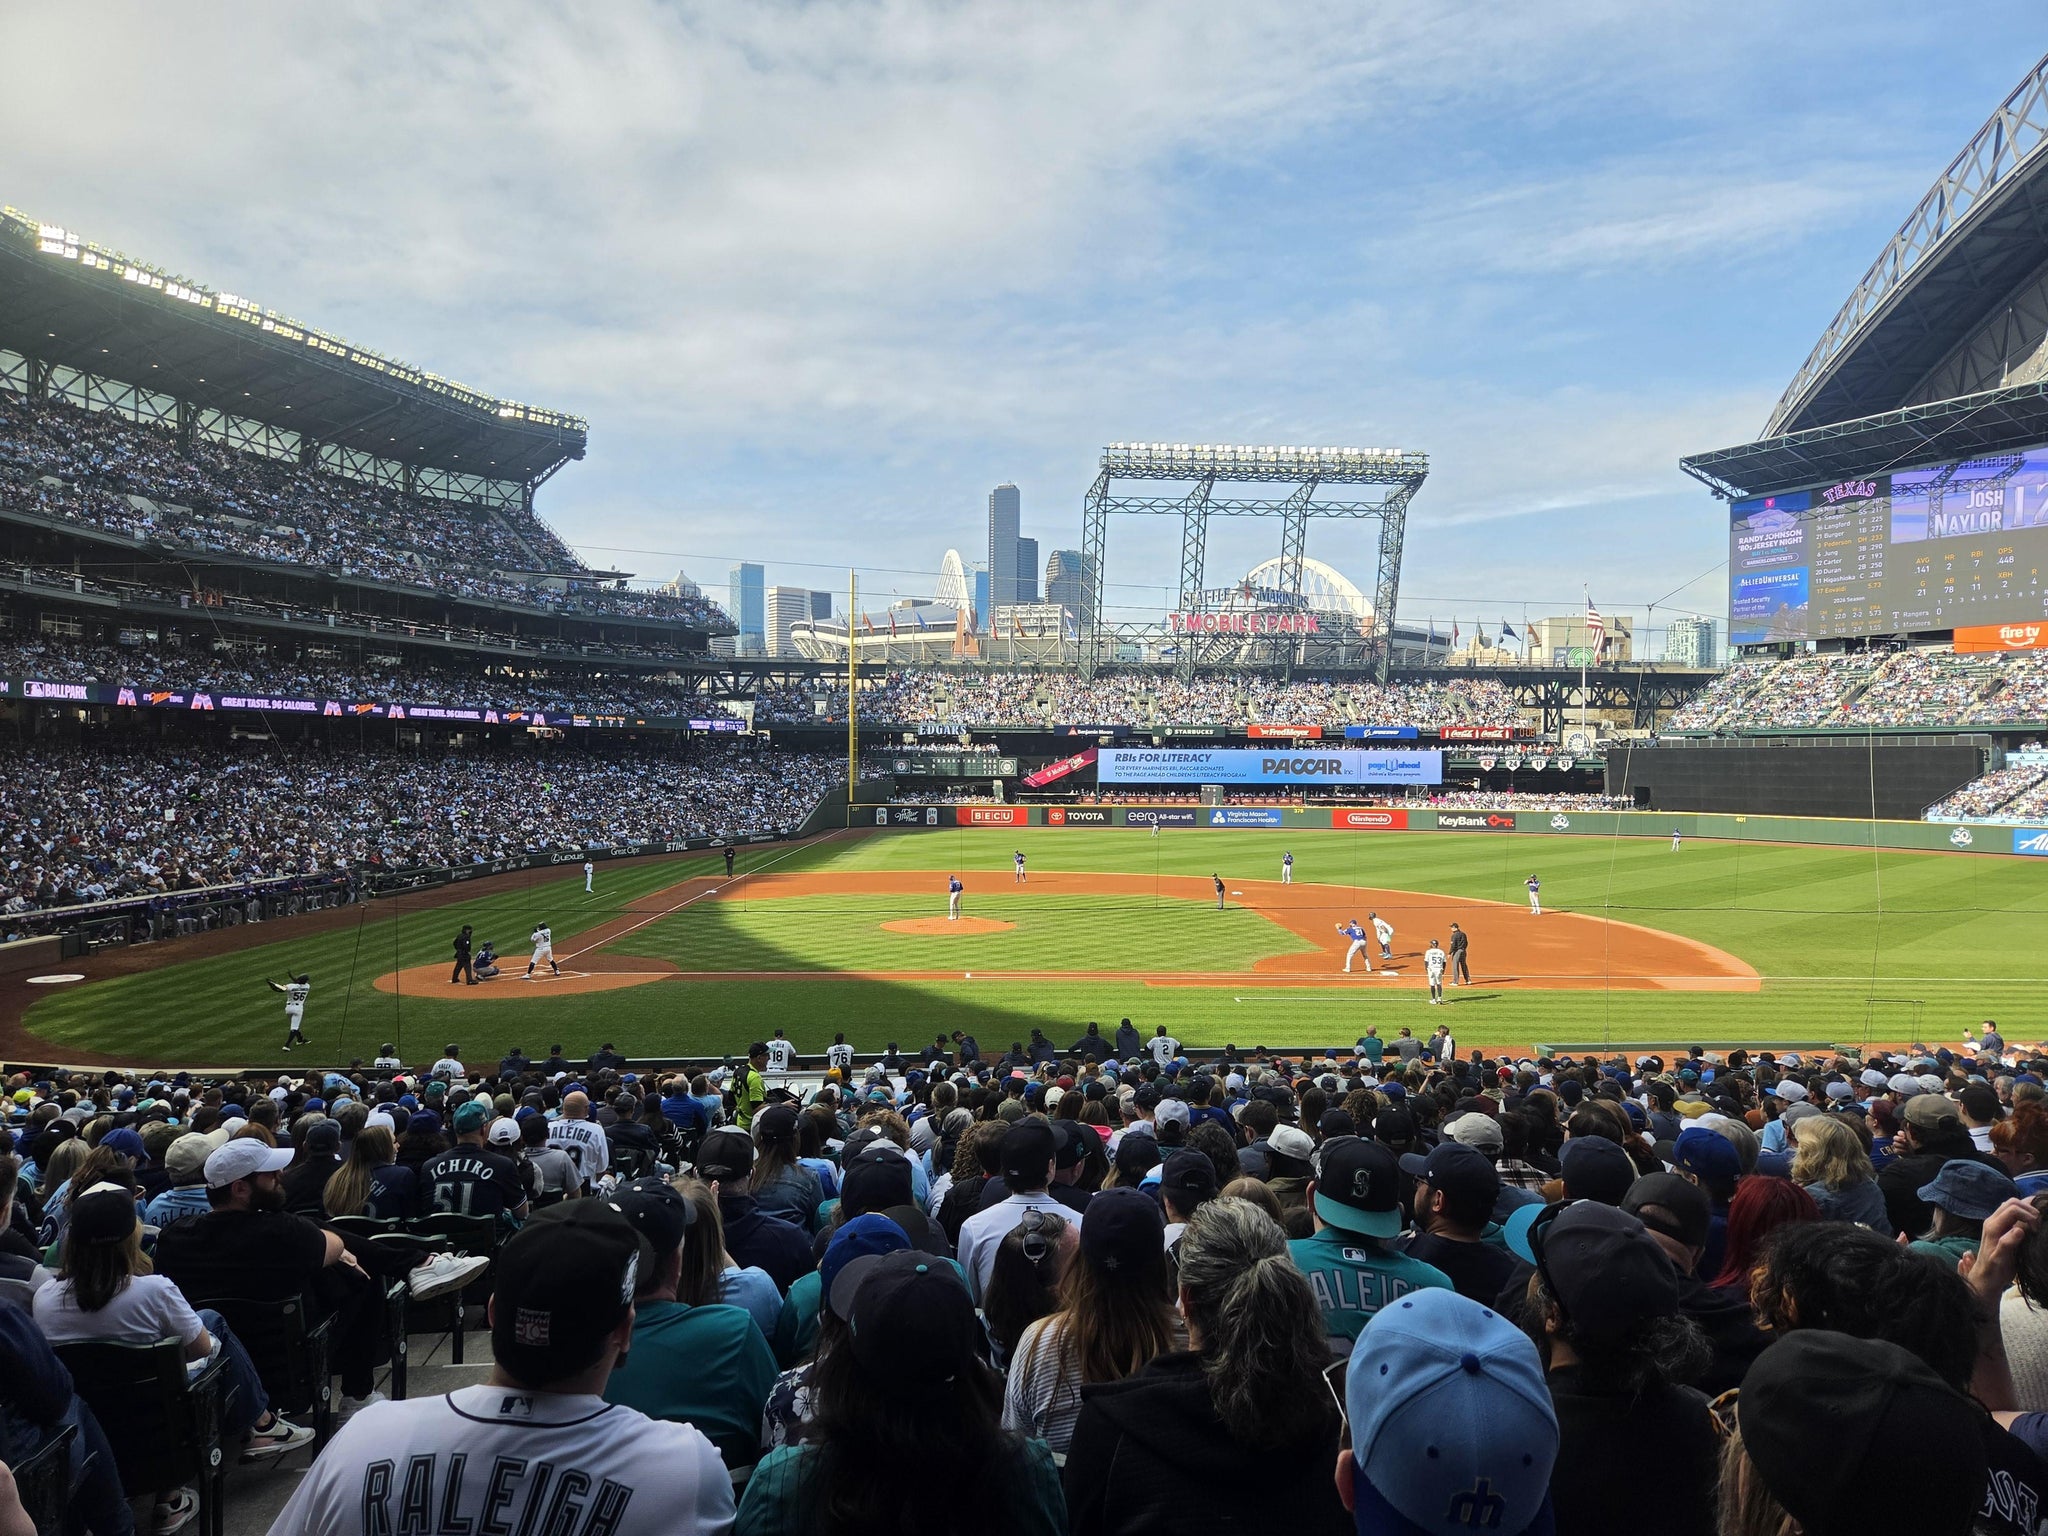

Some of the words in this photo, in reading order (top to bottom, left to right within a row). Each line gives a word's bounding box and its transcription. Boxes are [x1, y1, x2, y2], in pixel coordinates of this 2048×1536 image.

[1822, 481, 1877, 503] TEXAS
[1965, 489, 2004, 510] JOSH
[1824, 520, 1851, 530] Langford
[1934, 510, 2002, 536] NAYLOR
[1738, 534, 1765, 545] RANDY
[1765, 528, 1803, 540] JOHNSON
[1824, 531, 1845, 539] Burger
[1753, 540, 1779, 550] JERSEY
[1779, 536, 1804, 546] NIGHT
[1824, 539, 1852, 548] Pederson
[1914, 566, 1930, 574] .141
[1996, 556, 2014, 565] .448
[1824, 574, 1856, 584] Higashioka
[1256, 586, 1310, 609] MARINERS
[1936, 607, 1942, 616] 0
[1169, 613, 1262, 633] T-MOBILE
[1265, 613, 1321, 634] PARK
[1903, 620, 1930, 628] Mariners
[1999, 626, 2024, 639] fire
[2025, 626, 2040, 638] tv
[44, 683, 88, 700] BALLPARK
[222, 697, 246, 707] GREAT
[246, 698, 272, 709] TASTE.
[272, 700, 282, 709] 96
[283, 700, 318, 711] CALORIES.
[410, 708, 428, 716] GREAT
[446, 710, 454, 718] 96
[1450, 729, 1474, 738] Coca-Cola
[1480, 729, 1504, 738] Coca-Cola
[1114, 754, 1137, 762] RBIs
[1138, 754, 1160, 762] FOR
[1162, 754, 1212, 762] LITERACY
[1262, 758, 1342, 775] PACCAR
[1368, 762, 1386, 771] page
[1398, 760, 1420, 770] ahead
[974, 812, 1011, 820] BECU
[1068, 812, 1104, 821] TOYOTA
[1128, 812, 1156, 822] eero
[1438, 816, 1486, 828] KeyBank
[1953, 832, 1968, 840] 50
[610, 846, 627, 856] Great
[627, 846, 640, 855] Clips
[666, 841, 688, 852] STIHL
[560, 853, 584, 861] LEXUS
[1432, 956, 1442, 964] 53
[293, 992, 306, 1002] 56
[1162, 1044, 1169, 1055] 2
[772, 1050, 783, 1062] 18
[833, 1052, 848, 1065] 76
[430, 1158, 494, 1181] ICHIRO
[1352, 1168, 1372, 1198] S
[434, 1181, 475, 1216] 51
[362, 1452, 634, 1536] RALEIGH
